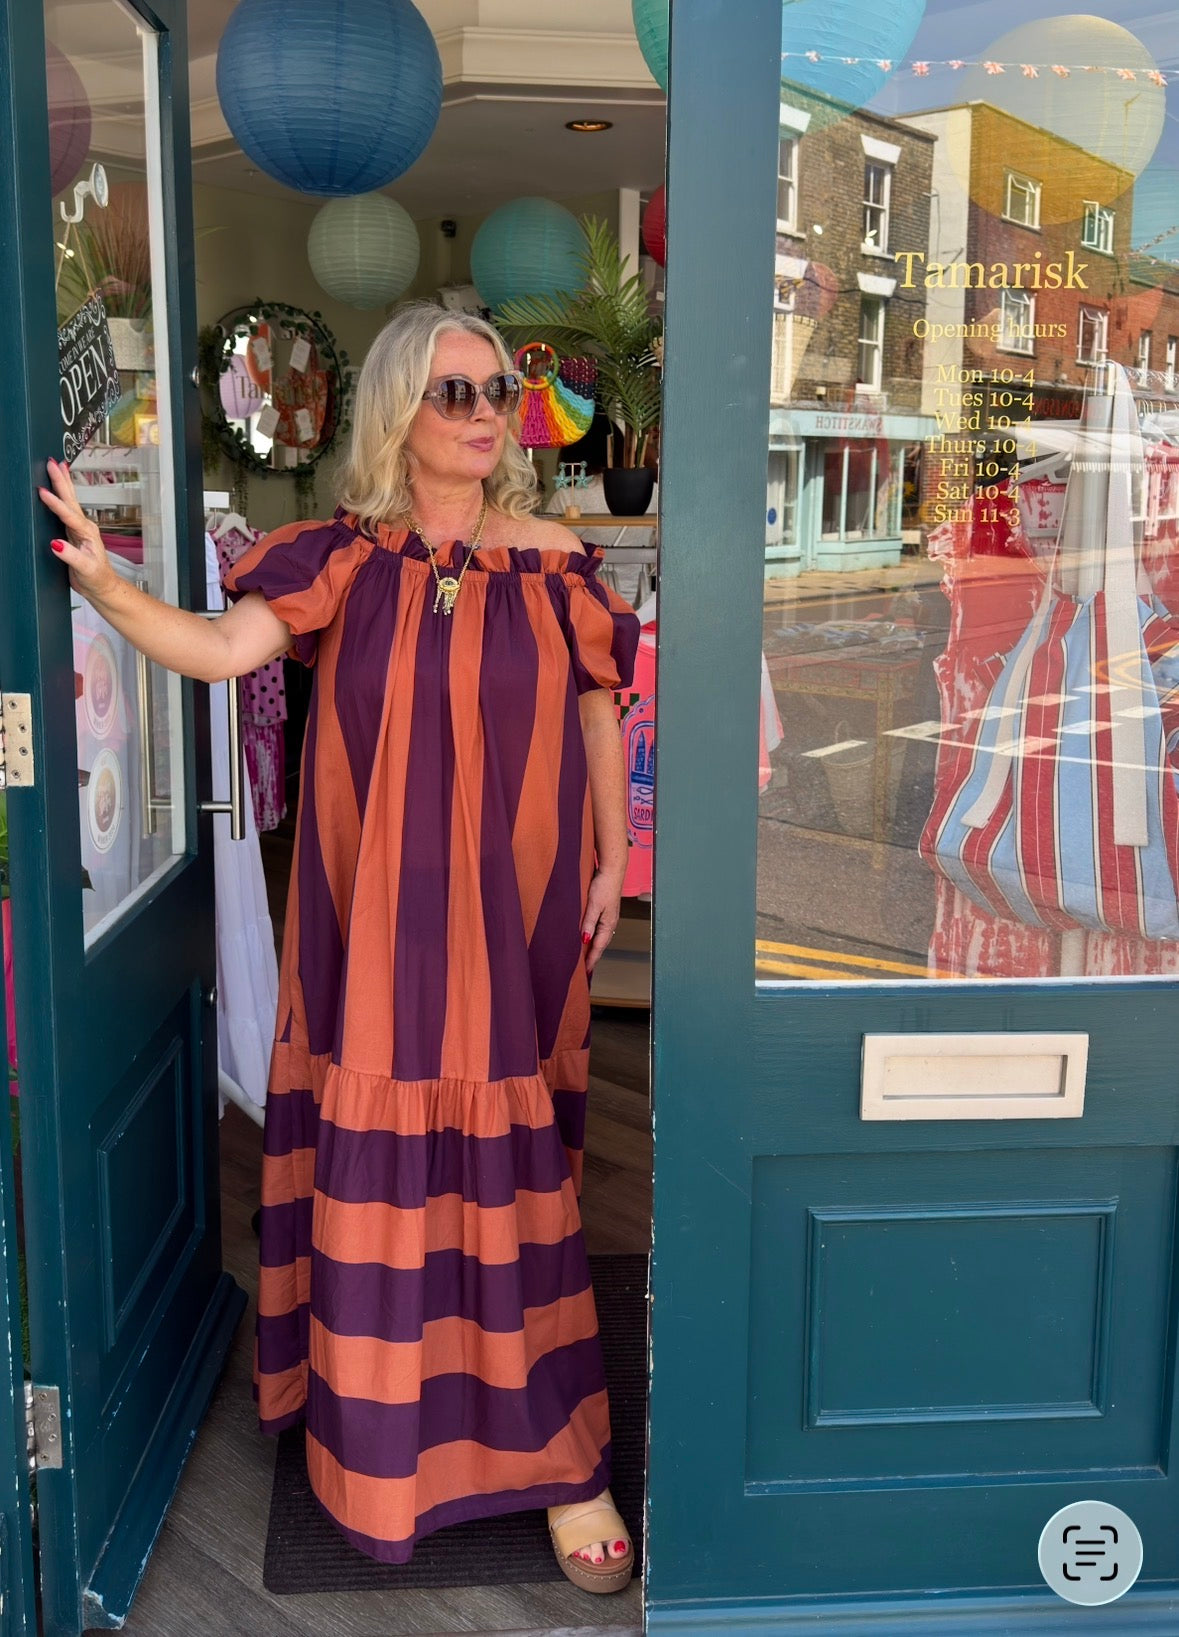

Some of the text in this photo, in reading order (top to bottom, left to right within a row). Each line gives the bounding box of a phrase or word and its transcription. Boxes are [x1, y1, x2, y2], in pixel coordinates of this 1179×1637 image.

[894, 251, 1089, 289] Tamarisk
[913, 318, 1067, 342] Opening hours
[59, 335, 109, 426] OPEN
[936, 364, 1035, 388] Mon 10-4
[933, 388, 1035, 411] Tues 10-4
[934, 410, 1032, 431] Wed 10-4
[925, 434, 1038, 458] Thurs 10-4
[939, 458, 1020, 481] Fri 10-4
[936, 481, 1020, 504] Sat 10-4
[934, 504, 1020, 527] Sun 11-3
